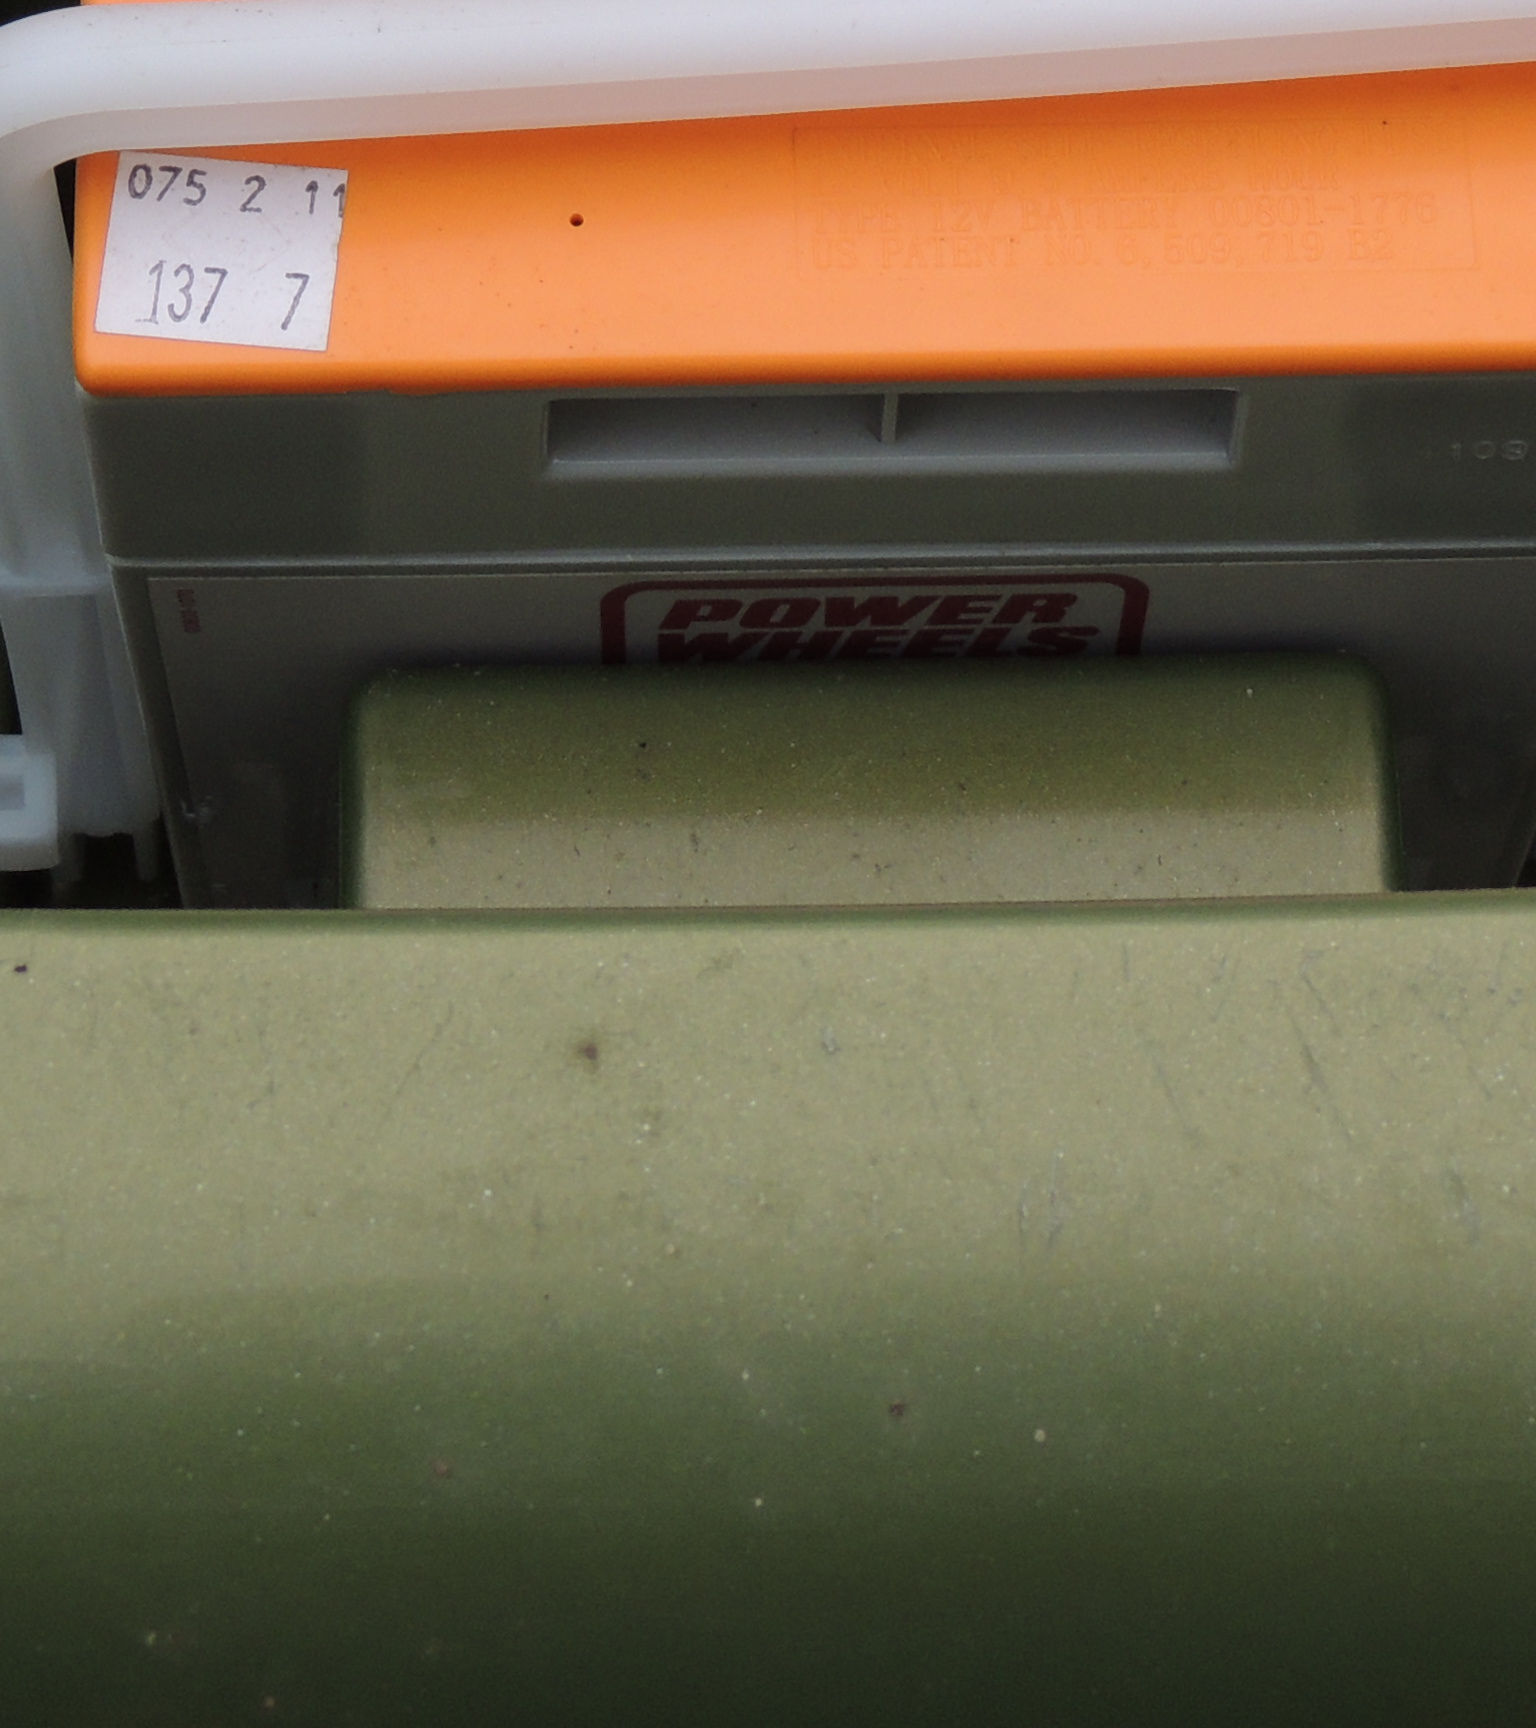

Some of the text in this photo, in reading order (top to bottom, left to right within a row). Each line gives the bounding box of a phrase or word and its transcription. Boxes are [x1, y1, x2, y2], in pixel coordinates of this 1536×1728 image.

[128, 163, 207, 206] 075
[239, 175, 267, 213] 2
[134, 260, 310, 331] 137 7
[658, 592, 1078, 630] POWER
[657, 626, 1099, 663] WHEELS
